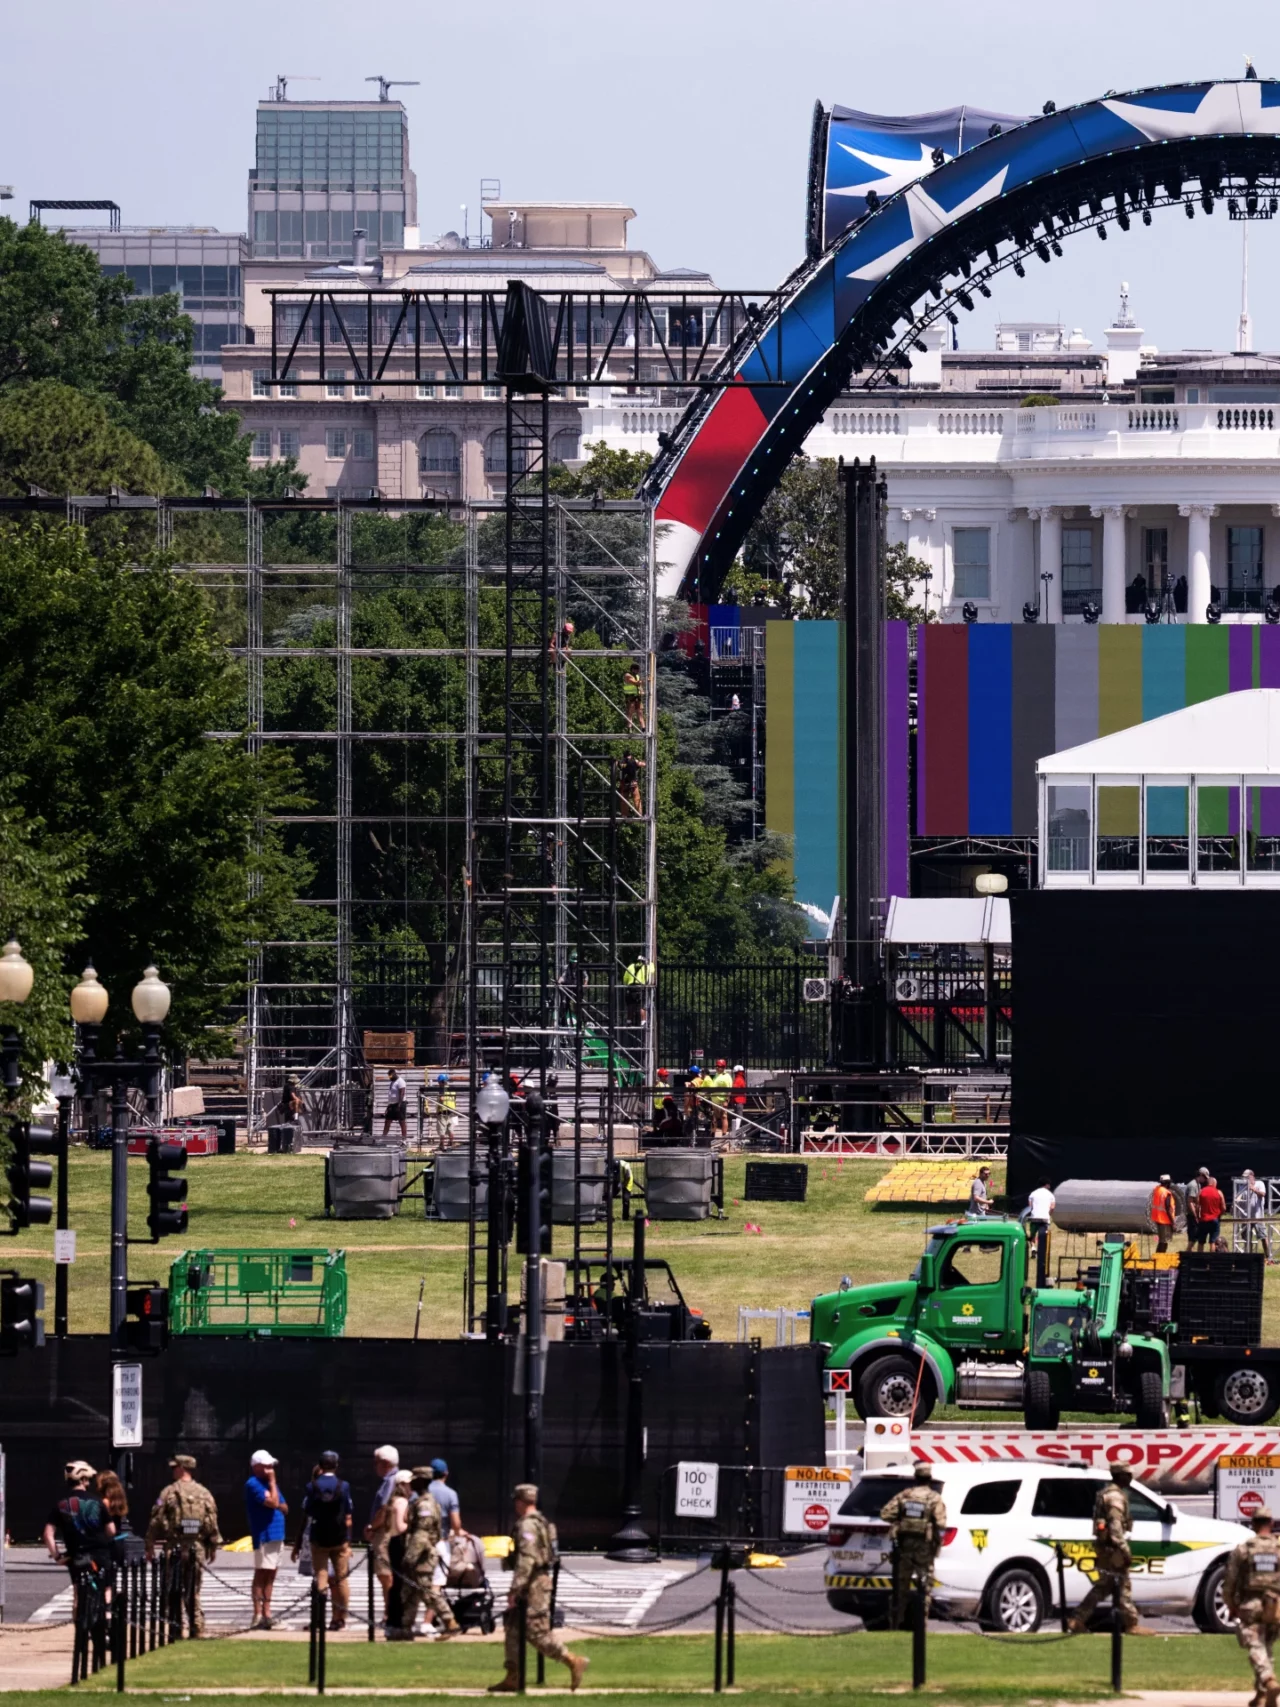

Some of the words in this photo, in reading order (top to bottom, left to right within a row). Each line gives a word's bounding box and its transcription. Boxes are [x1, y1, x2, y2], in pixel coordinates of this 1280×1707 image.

[1035, 1444, 1184, 1466] STOP
[1230, 1457, 1273, 1468] NOTICE
[796, 1469, 840, 1481] NOTICE
[1228, 1469, 1275, 1477] RESTRICTED
[1241, 1477, 1262, 1485] AREA
[795, 1482, 841, 1490] RESTRICTED
[691, 1487, 702, 1496] ID
[808, 1490, 828, 1498] AREA
[680, 1498, 712, 1508] CHECK
[1057, 1556, 1167, 1575] POCE
